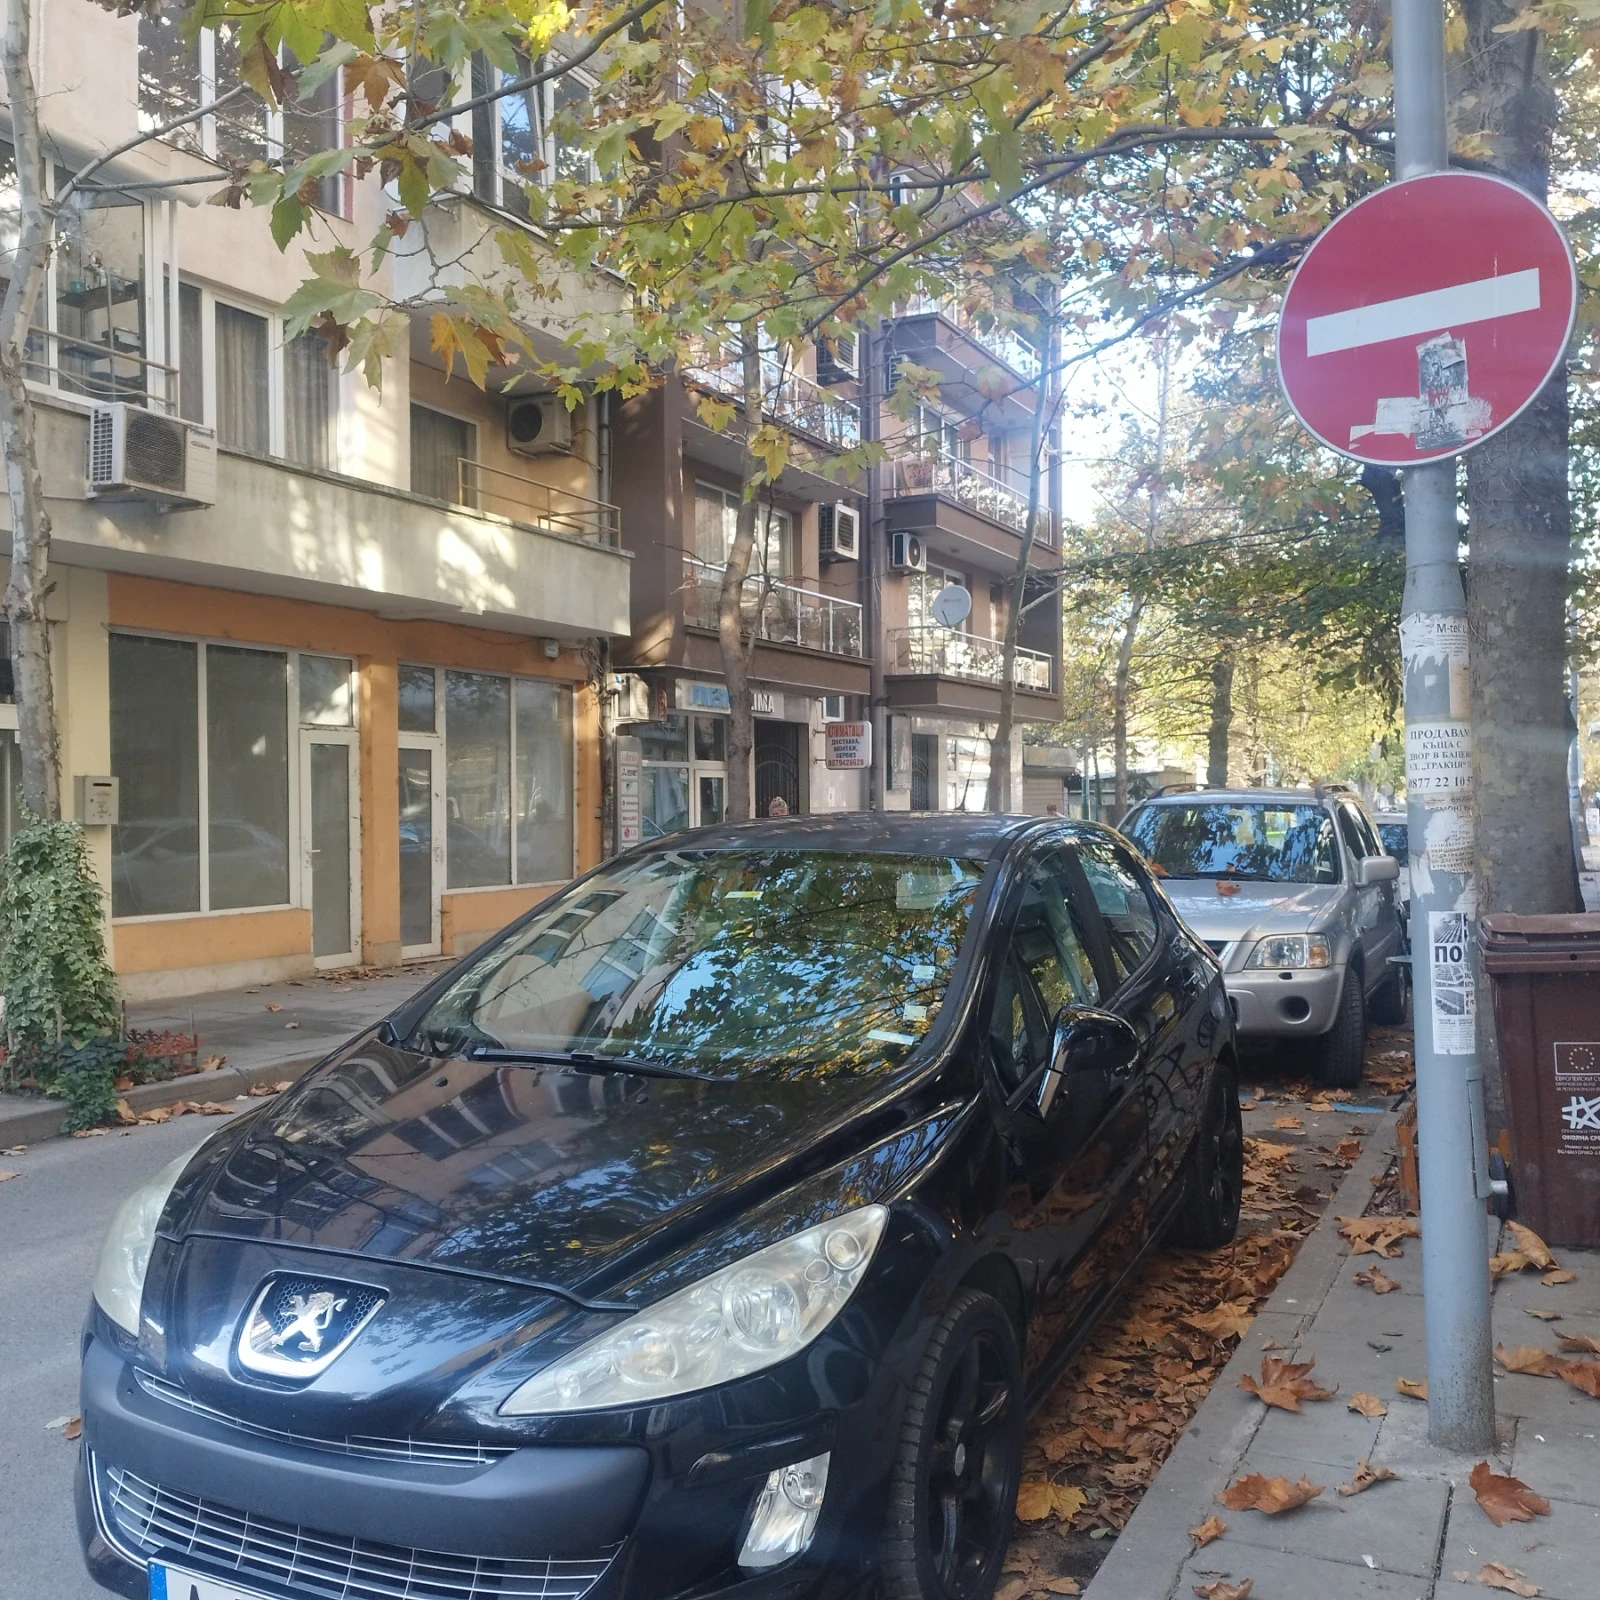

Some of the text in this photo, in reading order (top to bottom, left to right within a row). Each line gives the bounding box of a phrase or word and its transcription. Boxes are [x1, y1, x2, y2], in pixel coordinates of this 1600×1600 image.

[828, 724, 865, 738] КЛИМАТИЦИ
[1422, 740, 1463, 750] КЪЩА С
[1408, 752, 1431, 762] ДВОР
[1408, 777, 1431, 789] 0877
[1435, 776, 1450, 787] 22
